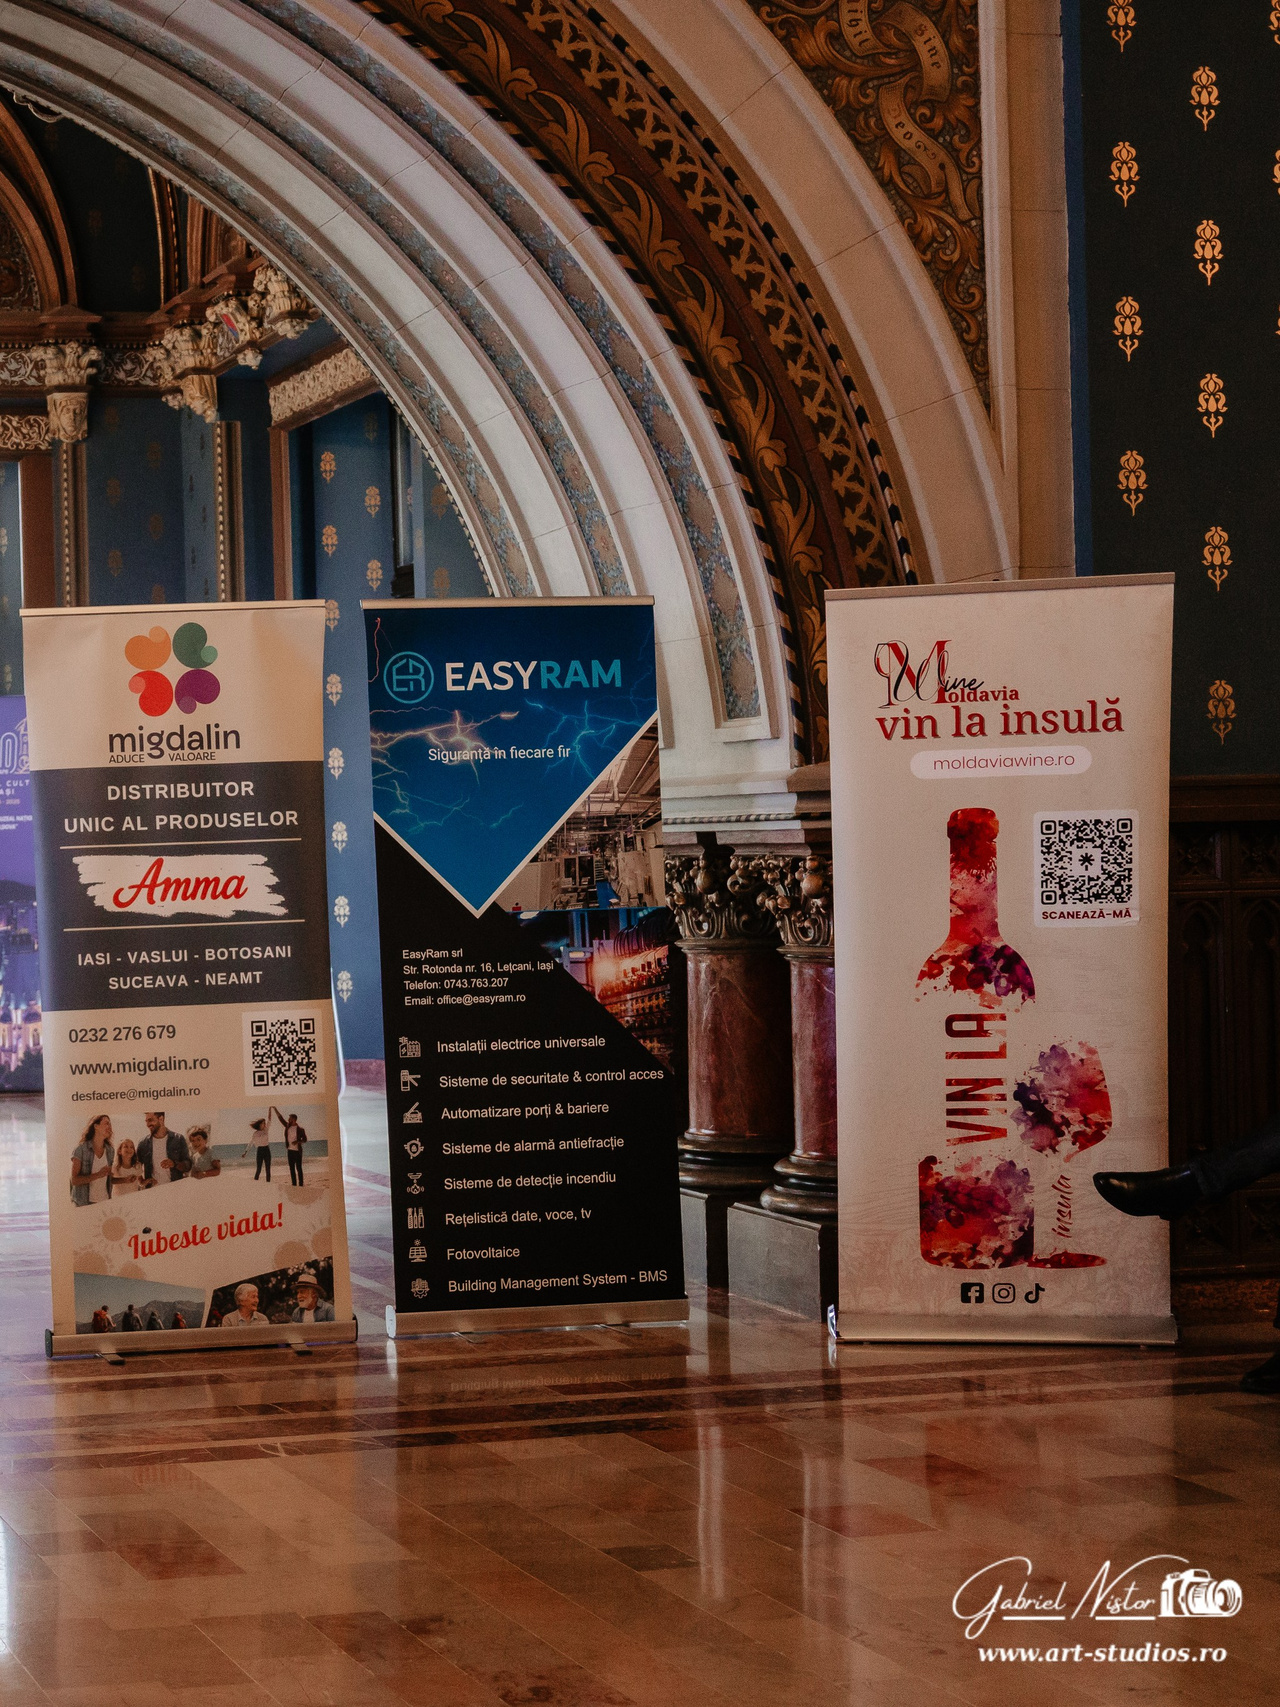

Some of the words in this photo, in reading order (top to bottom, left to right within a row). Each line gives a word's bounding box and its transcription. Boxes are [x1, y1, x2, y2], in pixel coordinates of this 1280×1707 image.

[446, 660, 622, 692] EASYRAM
[876, 708, 940, 740] vin
[951, 706, 988, 737] la
[1000, 697, 1124, 736] insulă
[109, 723, 240, 759] migdalin
[109, 754, 144, 763] ADUCE
[168, 752, 216, 761] VALOARE
[428, 748, 490, 764] Siguranță
[494, 746, 506, 759] în
[510, 746, 554, 759] fiecare
[558, 745, 571, 758] fir
[934, 754, 1074, 770] moldaviawine.ro
[108, 781, 254, 800] DISTRIBUITOR
[64, 817, 114, 832] UNIC
[122, 816, 148, 831] AL
[156, 811, 298, 830] PRODUSELOR
[113, 857, 248, 908] Amma
[1042, 908, 1132, 920] SCANEAZĂ-MĂ
[78, 953, 110, 966] IASI
[128, 950, 188, 964] VASLUI
[206, 946, 291, 960] BOTOSANI
[402, 950, 448, 960] EasyRam
[451, 949, 462, 958] srl
[403, 965, 419, 974] Str.
[422, 964, 462, 974] Rotonda
[465, 964, 477, 972] nr.
[480, 963, 494, 974] 16,
[498, 962, 534, 973] Lețcani,
[537, 961, 554, 972] Iași
[109, 974, 188, 990] SUCEAVA
[206, 972, 262, 985] NEAMT
[404, 980, 441, 990] Telefon:
[444, 978, 508, 988] 0743.763.207
[405, 996, 434, 1005] Email:
[437, 994, 526, 1005] office@easyram.ro
[69, 1027, 108, 1043] 0232
[114, 1027, 142, 1041] 276
[146, 1025, 176, 1039] 679
[945, 1013, 1007, 1059] LA
[437, 1040, 487, 1054] Instalații
[491, 1038, 541, 1050] electrice
[545, 1036, 605, 1048] universale
[70, 1056, 210, 1076] www.migdalin.ro
[440, 1075, 488, 1087] Sisteme
[492, 1074, 507, 1085] de
[511, 1072, 569, 1085] securitate
[573, 1071, 582, 1082] &
[585, 1069, 625, 1082] control
[629, 1069, 664, 1080] acces
[71, 1086, 201, 1102] desfacere@migdalin.ro
[441, 1106, 521, 1119] Automatizare
[525, 1104, 551, 1118] porți
[555, 1103, 564, 1114] &
[568, 1102, 609, 1114] bariere
[946, 1078, 1007, 1146] VIN
[442, 1142, 491, 1155] Sisteme
[495, 1142, 510, 1152] de
[514, 1139, 555, 1152] alarmă
[559, 1136, 624, 1151] antiefracție
[444, 1177, 493, 1190] Sisteme
[497, 1177, 511, 1187] de
[516, 1174, 562, 1188] detecție
[566, 1172, 616, 1184] incendiu
[1051, 1175, 1071, 1238] insula
[446, 1211, 507, 1227] Rețelistică
[512, 1210, 542, 1223] date,
[546, 1209, 577, 1221] voce,
[581, 1208, 591, 1218] tv
[128, 1224, 212, 1259] Iubeste
[217, 1203, 283, 1237] viata!
[447, 1247, 520, 1260] Fotovoltaice
[448, 1280, 497, 1293] Building
[501, 1277, 579, 1291] Management
[583, 1273, 627, 1287] System
[639, 1270, 667, 1282] BMS
